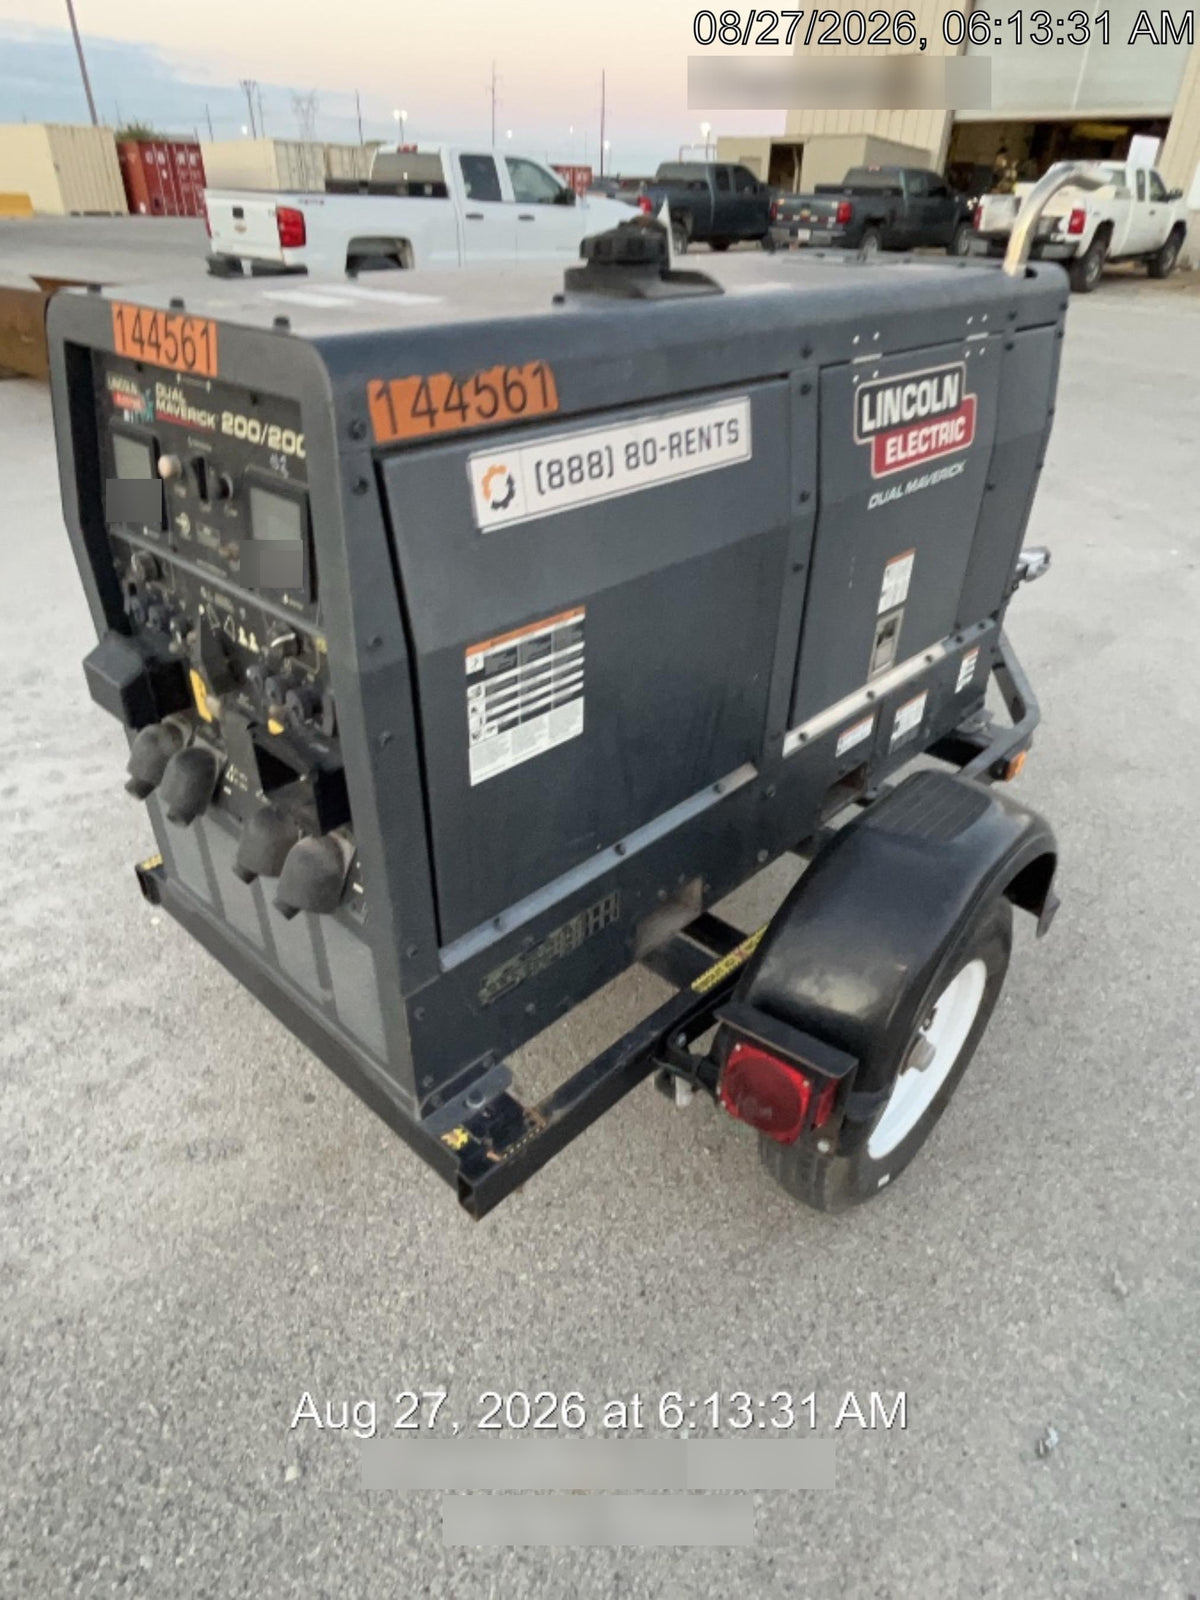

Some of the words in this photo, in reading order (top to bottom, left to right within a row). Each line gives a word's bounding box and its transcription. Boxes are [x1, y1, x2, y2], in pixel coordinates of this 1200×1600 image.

[115, 307, 211, 374] 144561
[373, 361, 549, 435] 144561
[861, 373, 960, 434] LINCOLN
[534, 445, 614, 495] (888)
[624, 417, 740, 471] 80-RENTS
[884, 415, 968, 466] ELECTRIC
[867, 485, 904, 510] DUAL
[905, 461, 967, 495] MAVERICK
